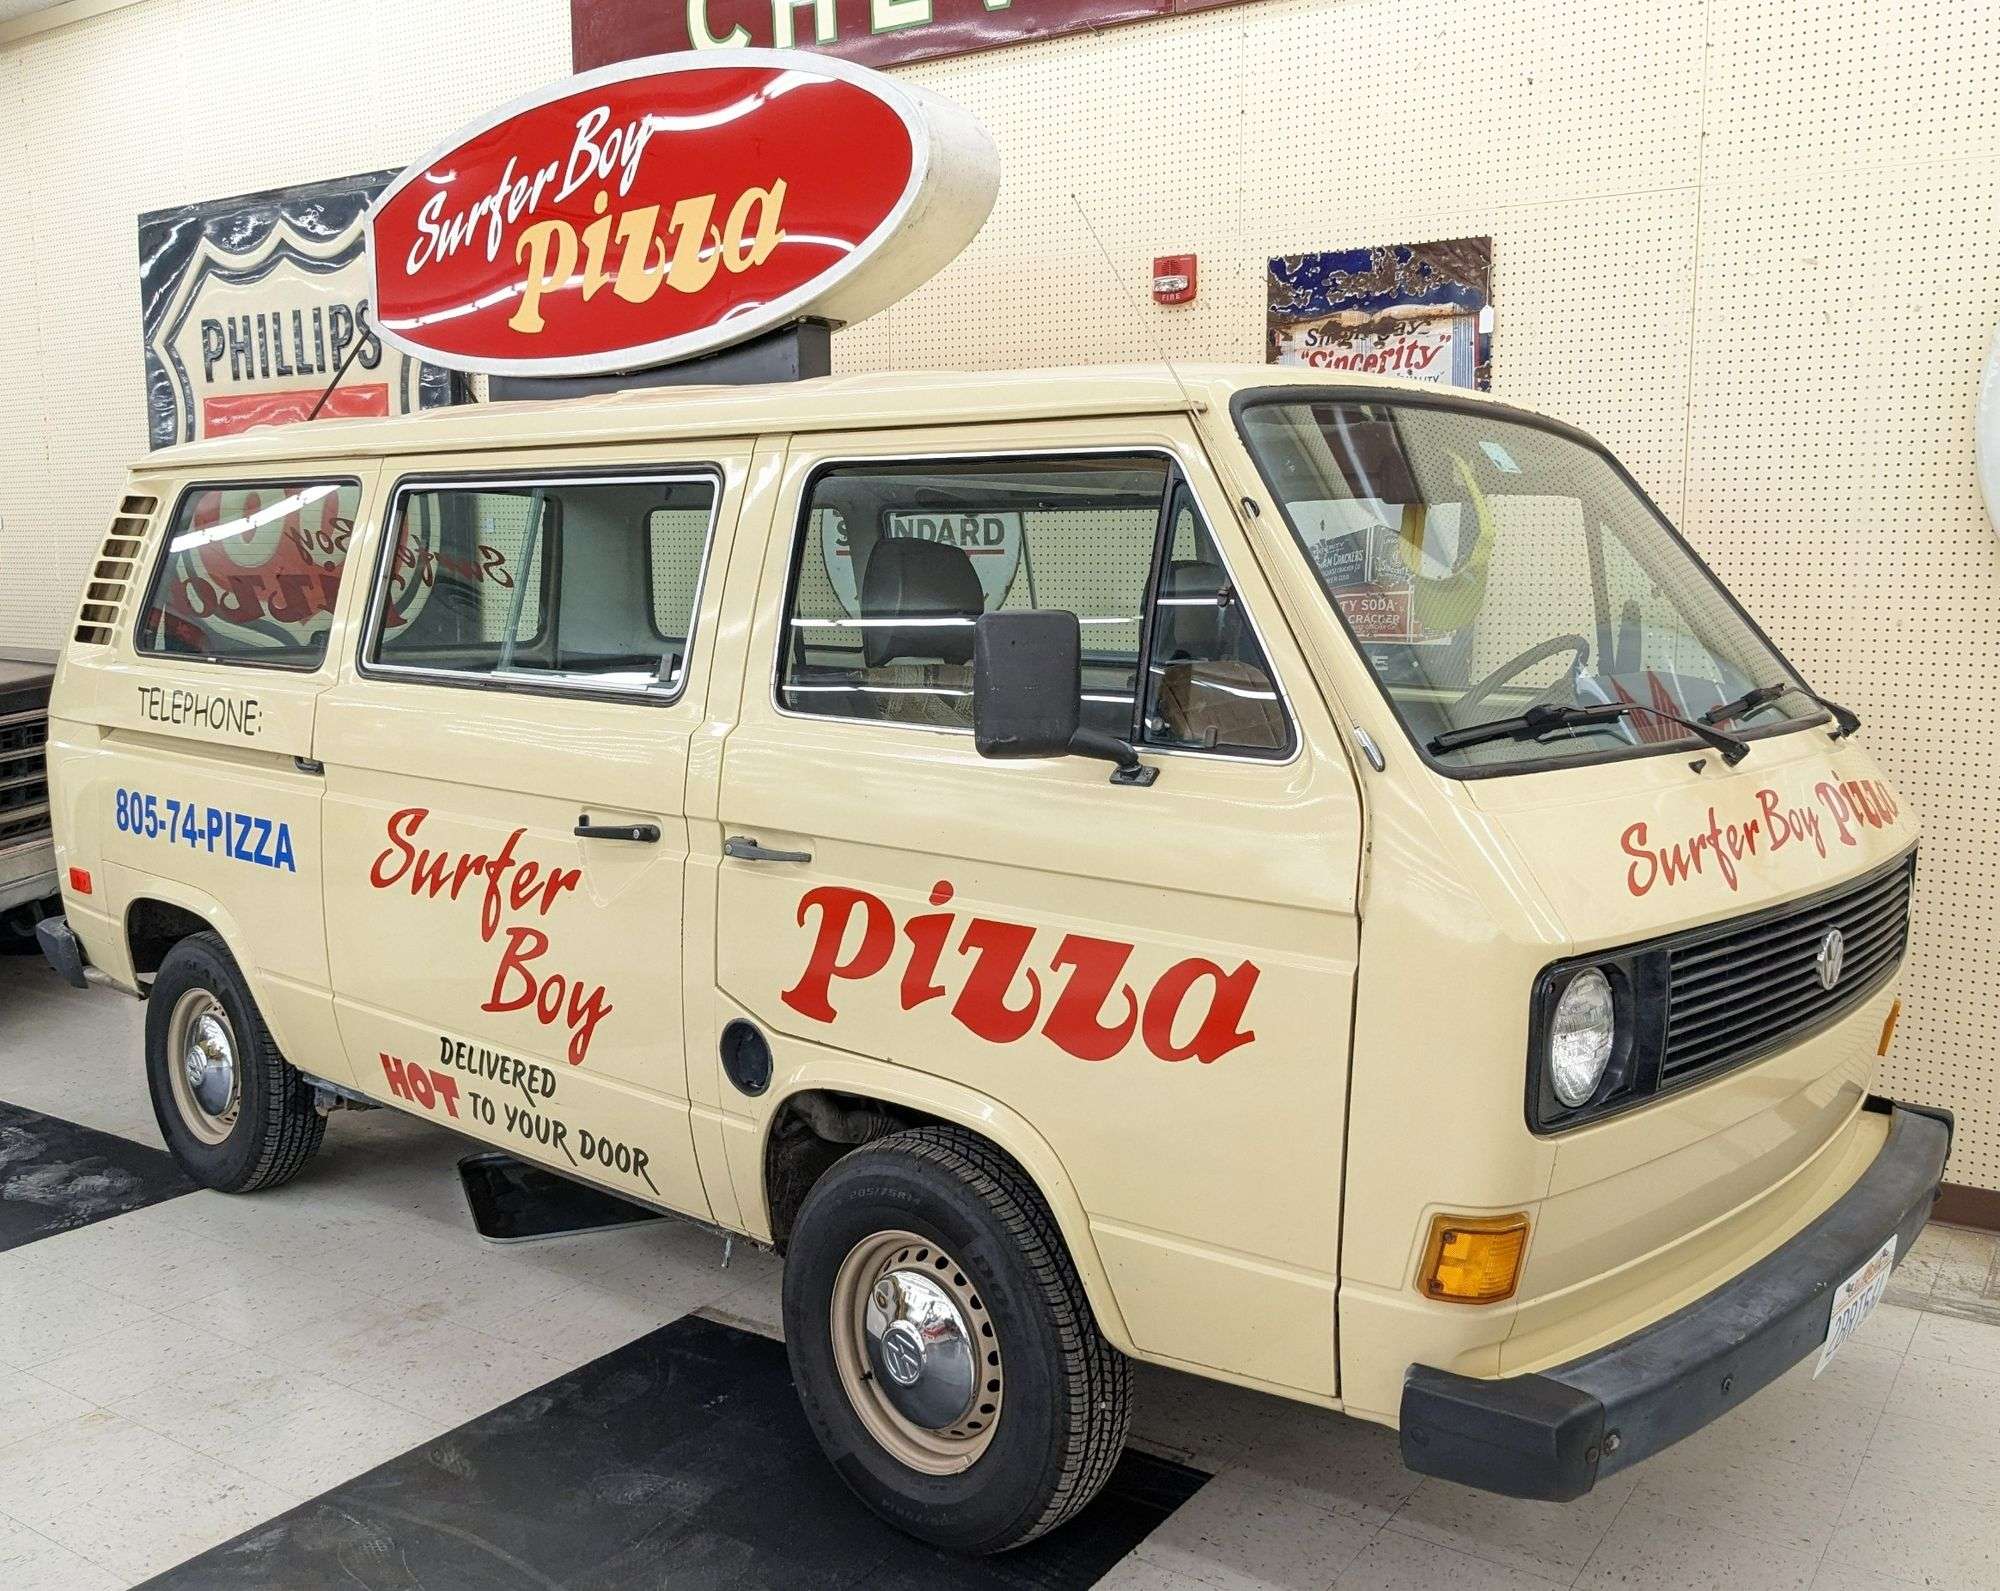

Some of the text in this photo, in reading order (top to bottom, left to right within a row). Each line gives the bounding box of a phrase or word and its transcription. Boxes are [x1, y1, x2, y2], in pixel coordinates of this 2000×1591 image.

[405, 105, 656, 276] Surfer Boy
[201, 298, 382, 383] PHILLIPS
[835, 517, 1005, 547] SNDARD
[1361, 599, 1395, 611] SODA
[138, 686, 262, 736] TELEPHONE:
[115, 788, 297, 873] 805-74-PIZZA
[1620, 807, 1760, 897] Surfer
[1755, 788, 1826, 859] Boy
[369, 807, 582, 942] Surfer
[480, 926, 613, 1066] Boy
[440, 1036, 557, 1108] DELIVERED
[379, 1052, 660, 1196] HOT TO YOUR DOOR
